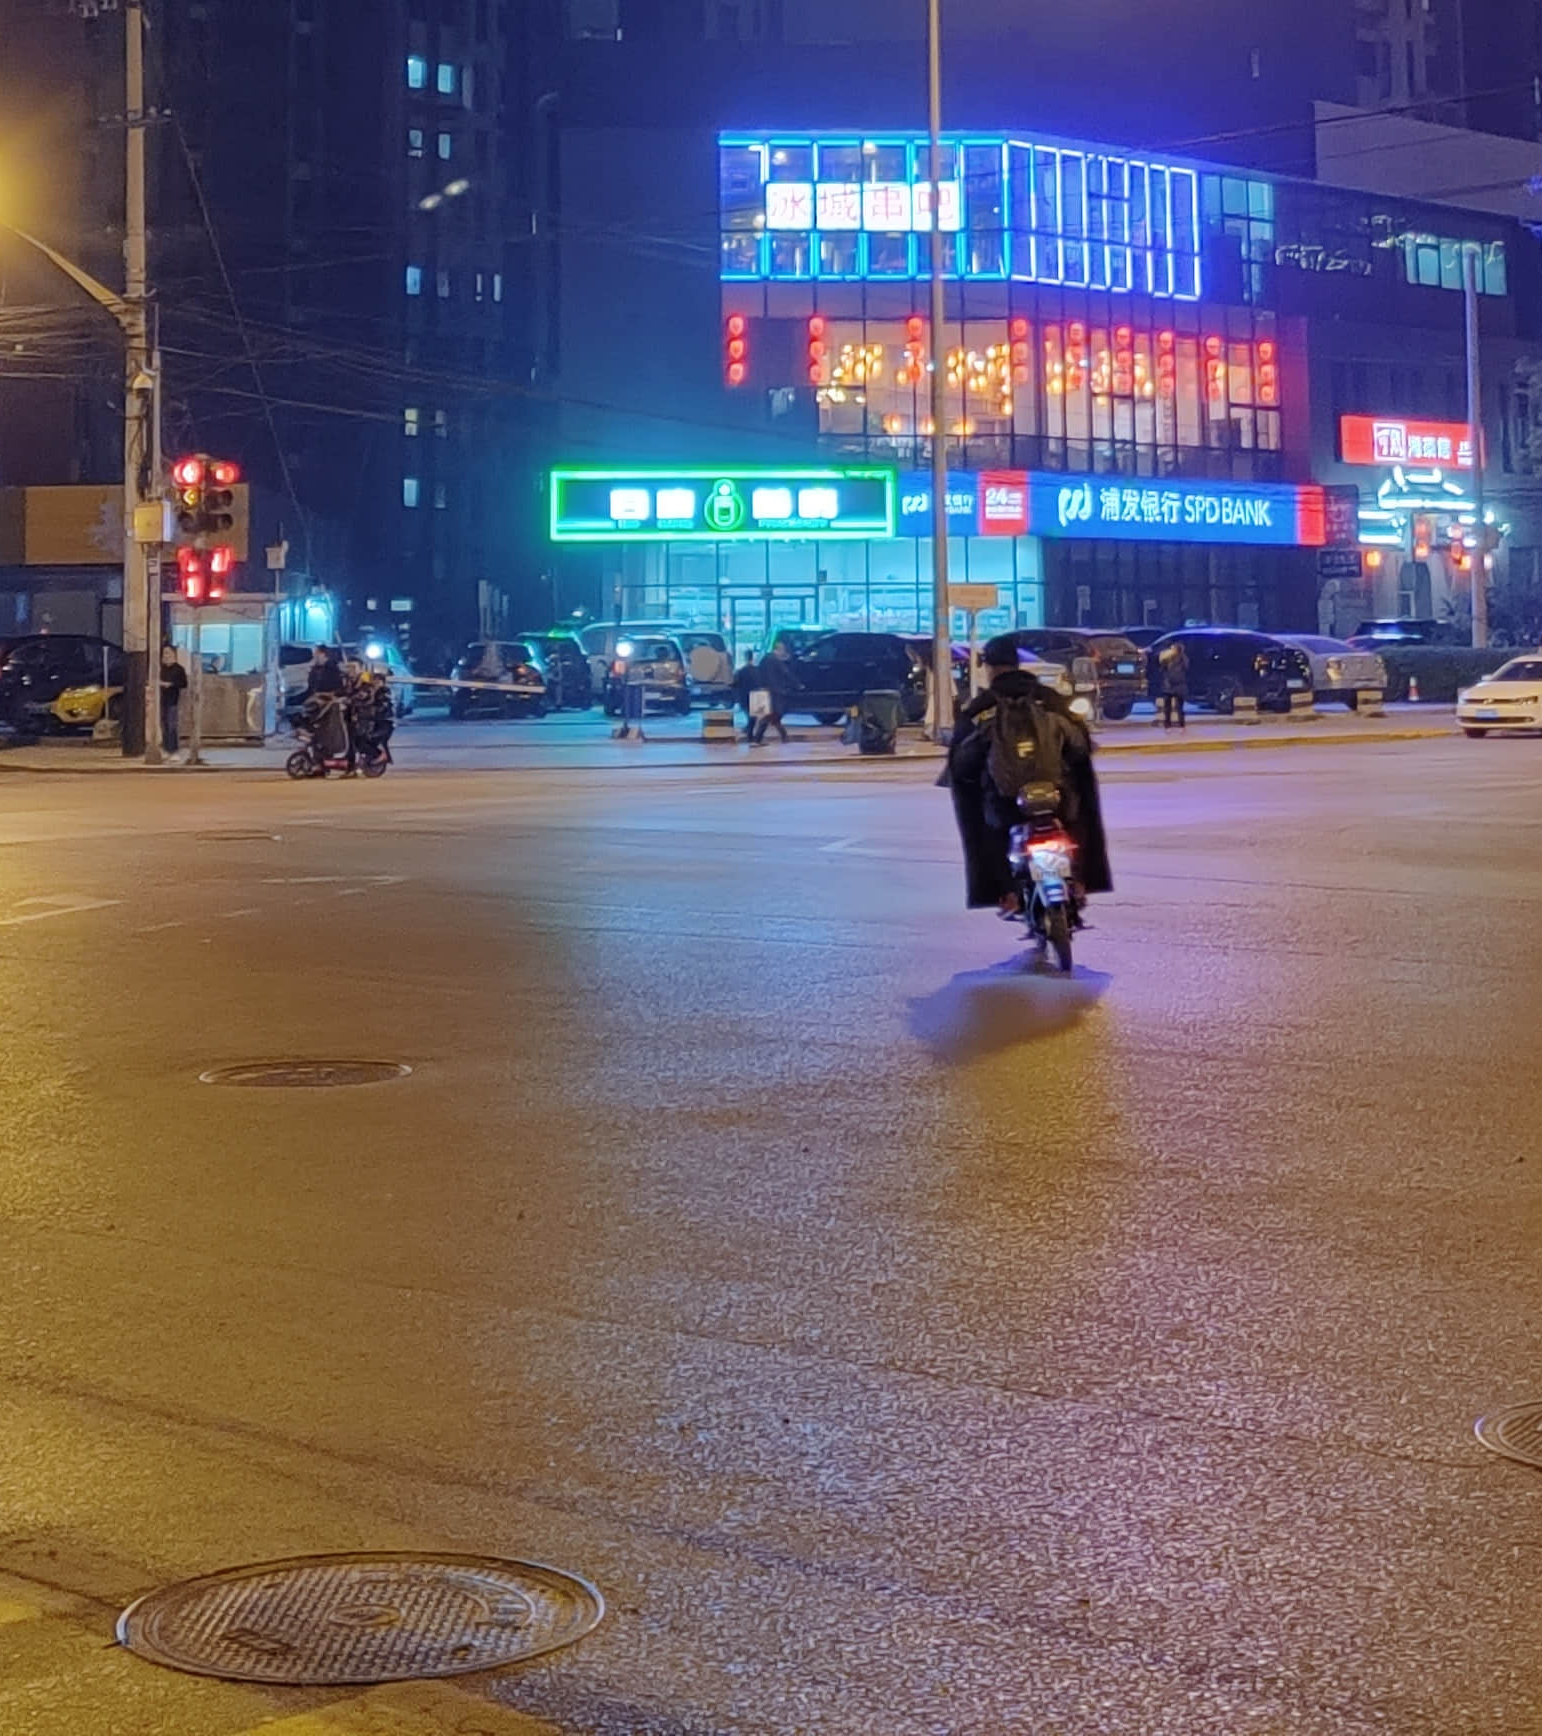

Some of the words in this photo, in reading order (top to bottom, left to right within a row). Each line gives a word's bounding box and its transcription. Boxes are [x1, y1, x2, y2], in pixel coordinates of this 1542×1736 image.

[1100, 487, 1180, 524] 浦发银行
[1184, 495, 1220, 524] SPD
[1221, 497, 1272, 527] BANK
